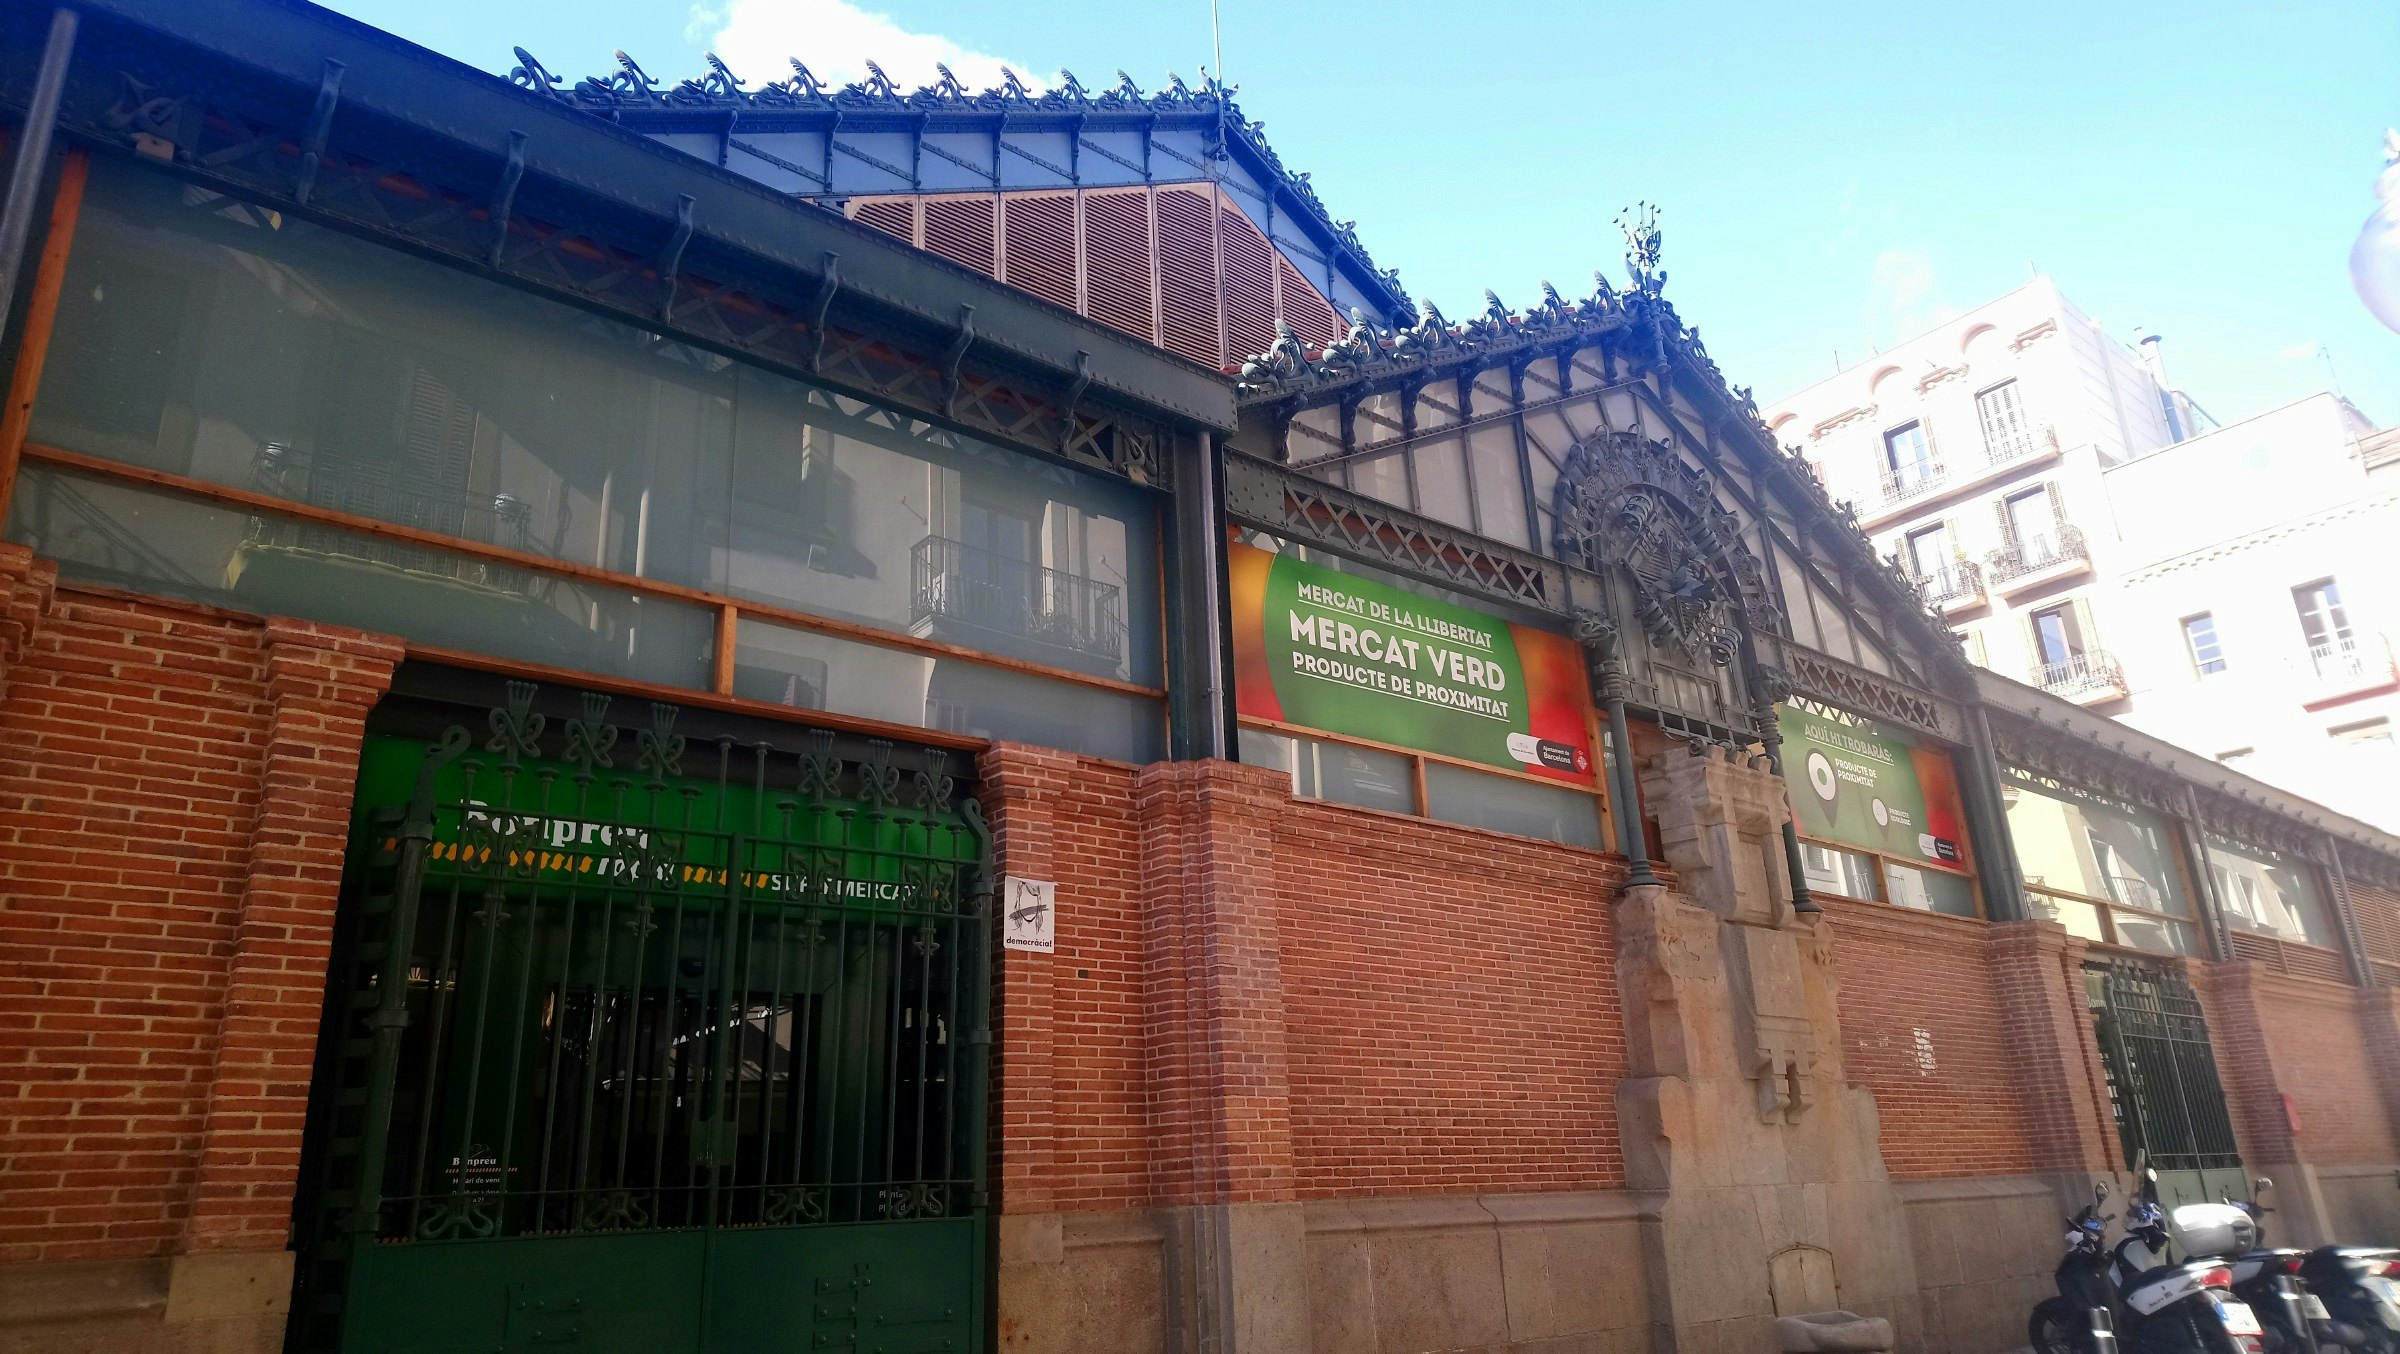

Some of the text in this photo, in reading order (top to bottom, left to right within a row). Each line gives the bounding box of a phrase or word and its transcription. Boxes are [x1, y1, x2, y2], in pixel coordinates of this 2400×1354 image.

[1297, 581, 1492, 649] MERCAT DE LA LLIBERTAT
[1289, 609, 1506, 692] MERCAT VERD
[1292, 651, 1509, 718] PRODUCTE DE PROXIMITAT
[1830, 731, 1842, 747] HI
[1543, 751, 1571, 764] Barcelona
[1834, 758, 1878, 779] PRODUCTE DE
[1837, 770, 1874, 788] PROXIMITAT
[452, 1157, 497, 1167] Bnpreu
